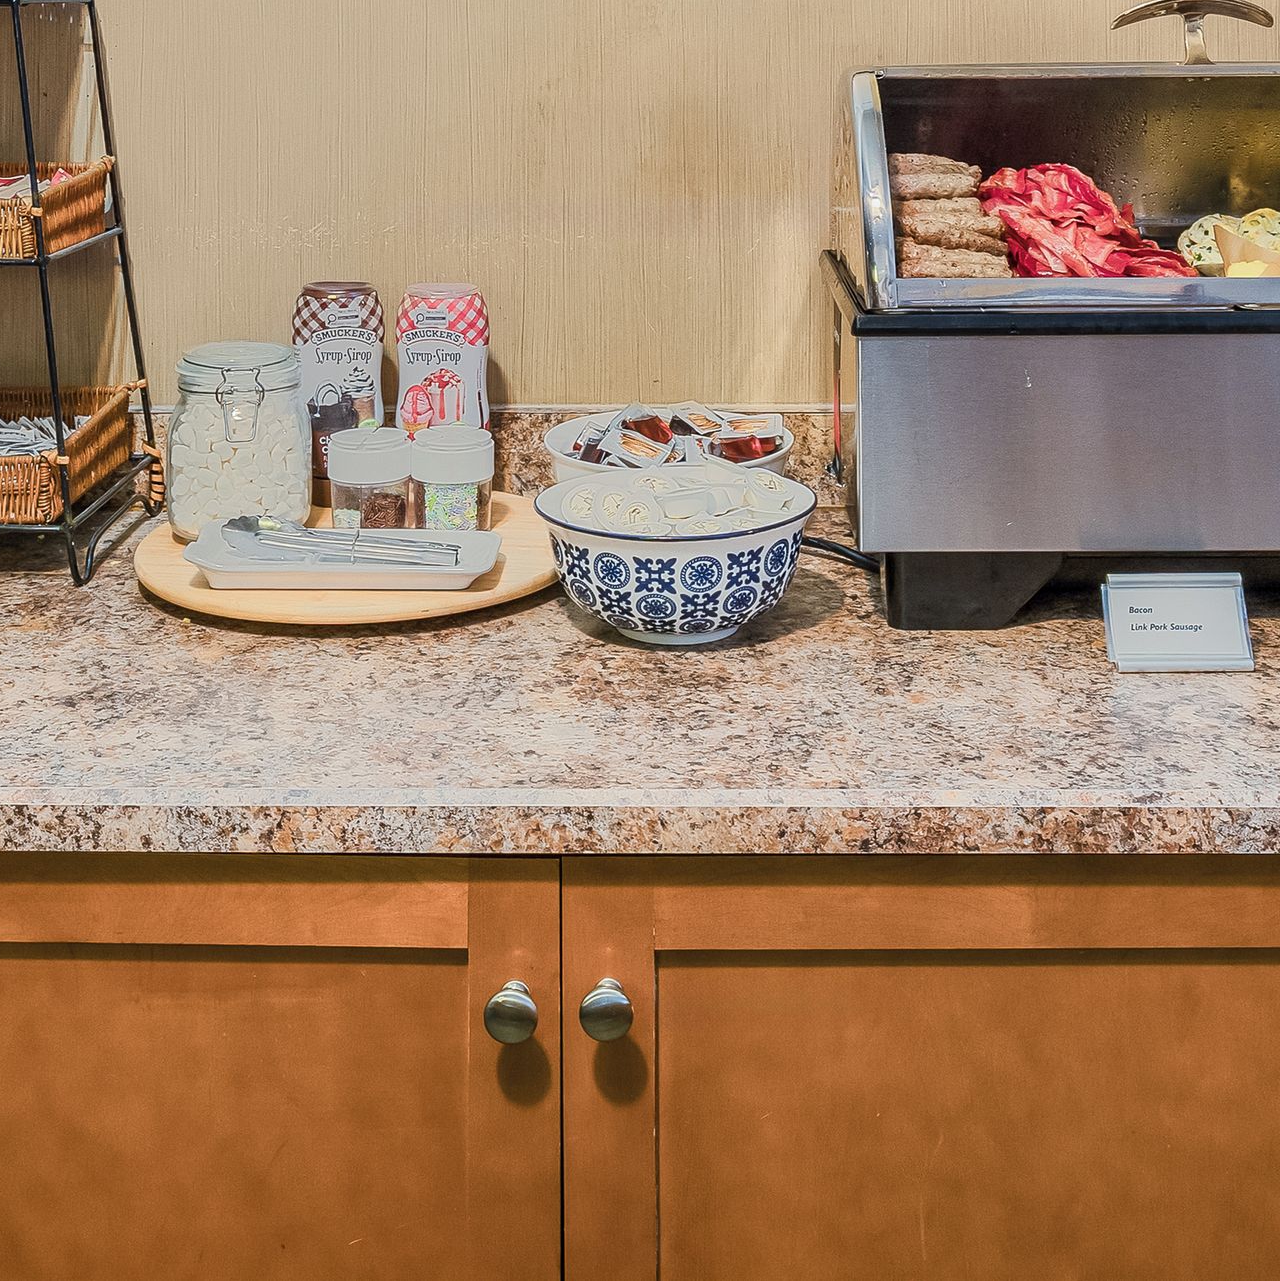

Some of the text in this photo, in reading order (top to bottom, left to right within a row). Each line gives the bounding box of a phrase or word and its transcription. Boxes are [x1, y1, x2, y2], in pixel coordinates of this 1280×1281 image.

[315, 329, 374, 342] SMUCKER'S
[404, 329, 461, 343] SMUCKER'S
[1128, 606, 1153, 614] Bacon
[1131, 622, 1203, 633] Link Pork Sausage
